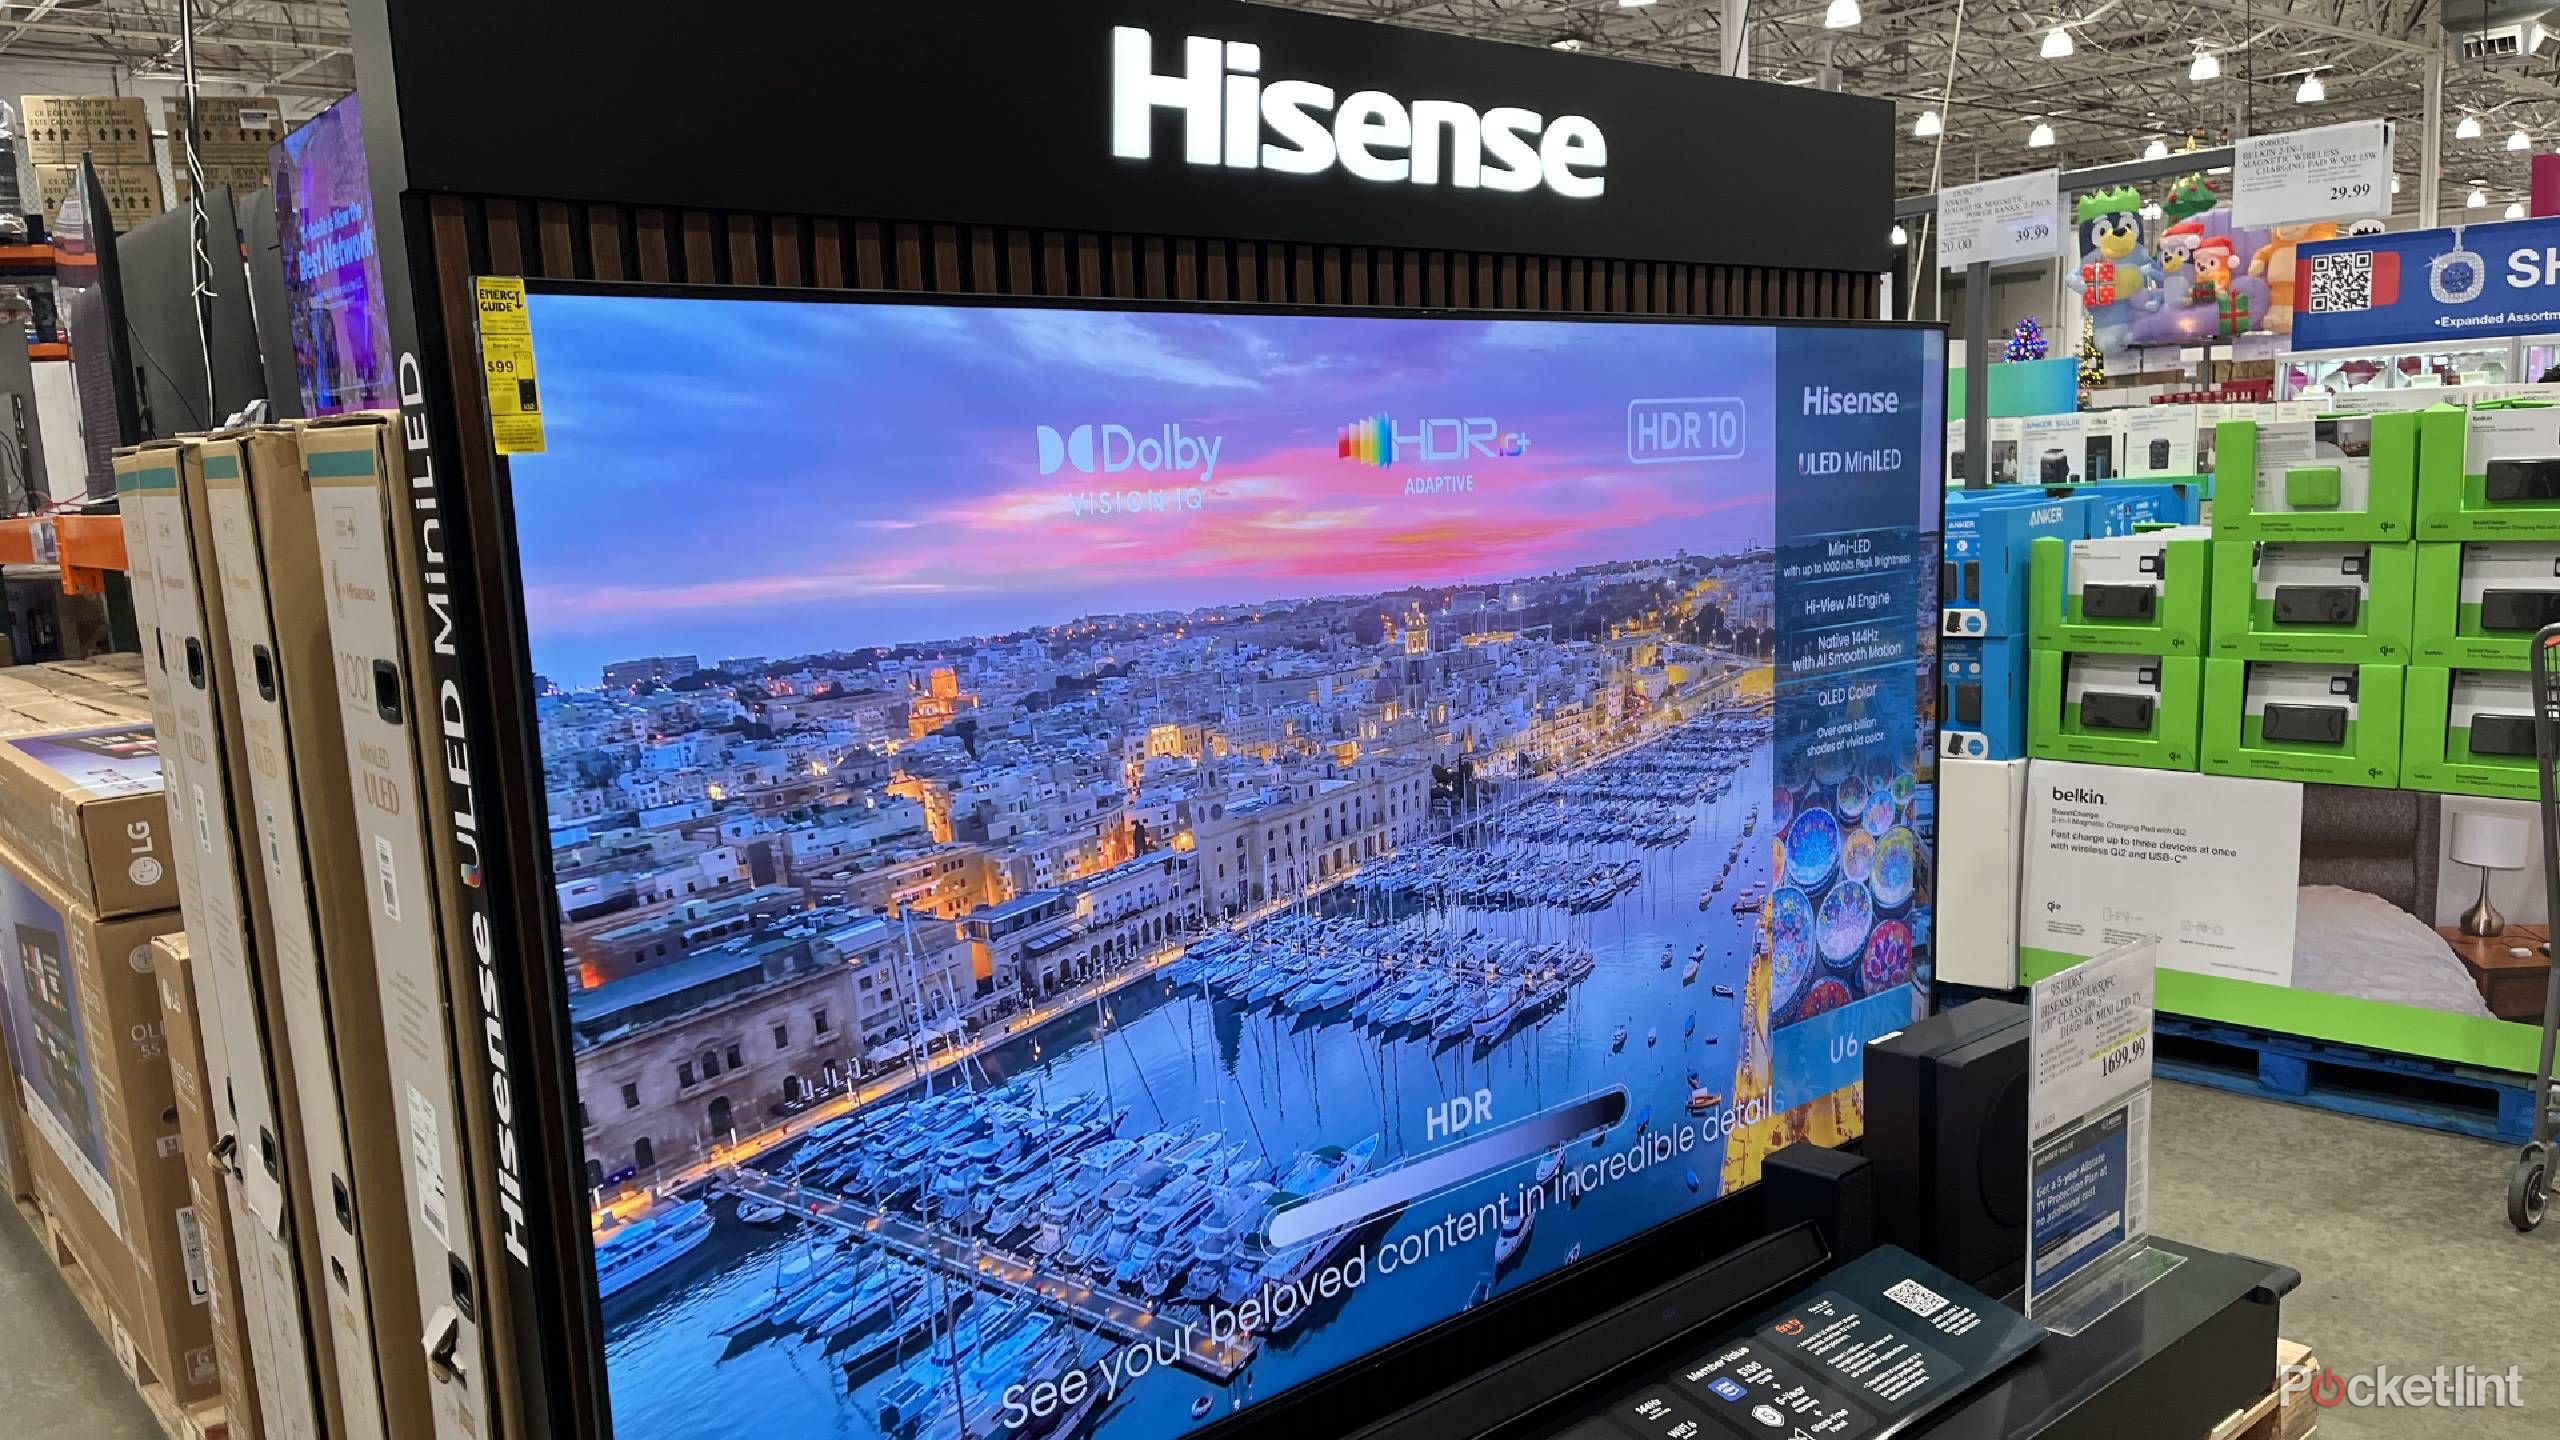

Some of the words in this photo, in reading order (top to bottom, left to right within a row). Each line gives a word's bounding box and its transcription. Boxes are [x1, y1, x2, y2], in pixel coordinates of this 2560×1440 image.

[1113, 26, 1607, 198] Hisense
[2294, 148, 2340, 161] WIRELESS
[2255, 162, 2305, 176] CHARGING
[2330, 183, 2371, 200] 29.99
[2015, 227, 2049, 243] 39.99
[298, 243, 324, 282] Best
[323, 221, 374, 273] Network
[480, 289, 521, 305] ENERGY
[480, 301, 513, 313] GUIDE
[487, 360, 513, 373] $99
[1803, 386, 1899, 416] Hisense
[1638, 412, 1701, 451] HDR
[1708, 410, 1738, 449] 10
[1101, 423, 1222, 482] Dolby
[1798, 452, 1842, 476] ULED
[1845, 449, 1902, 473] MiniLED
[1404, 474, 1474, 496] ADAPTIVE
[399, 352, 457, 657] MiniLED
[1069, 488, 1165, 517] VISION
[1176, 487, 1203, 513] IQ
[1948, 521, 1976, 529] ANKER
[2028, 507, 2064, 527] ANKER
[1828, 539, 1872, 557] Mini-LED
[1784, 564, 1801, 577] with
[1802, 564, 1813, 577] up
[1814, 562, 1822, 574] to
[1823, 560, 1840, 573] 1000
[1855, 556, 1874, 570] Peak
[1805, 597, 1845, 616] Hi-View
[1846, 594, 1856, 610] AI
[1858, 591, 1890, 610] Engine
[1818, 633, 1850, 651] Native
[1851, 628, 1880, 645] 144Hz
[1792, 655, 1816, 672] with
[1816, 654, 1826, 668] AI
[1828, 646, 1868, 666] Smooth
[1868, 642, 1902, 660] Motion
[1818, 688, 1846, 706] QLED
[1847, 682, 1878, 701] Color
[1816, 727, 1836, 738] Over
[1807, 741, 1836, 757] shades
[362, 768, 400, 816] ULED
[441, 679, 482, 889] ULED
[127, 821, 154, 854] LG
[2051, 829, 2071, 839] Fast
[2072, 832, 2105, 845] charge
[2106, 836, 2119, 846] up
[2120, 836, 2130, 846] to
[2132, 838, 2157, 849] three
[2159, 841, 2198, 854] devices
[2199, 844, 2210, 854] at
[2211, 847, 2237, 857] once
[2050, 841, 2069, 851] with
[2071, 843, 2109, 857] wireless
[2128, 849, 2146, 860] and
[2040, 994, 2073, 1019] HISENSE
[2057, 1007, 2084, 1026] CLASS
[2096, 1007, 2114, 1022] MINI
[1830, 1032, 1858, 1064] U6
[2102, 1036, 2146, 1078] 1699.99
[472, 911, 528, 1268] Hisense
[1426, 1088, 1493, 1141] HDR
[2036, 1199, 2046, 1213] TV
[2047, 1180, 2084, 1208] Protection
[2084, 1171, 2100, 1186] Plan
[1002, 1369, 1088, 1429] See
[1099, 1318, 1198, 1401] your
[1209, 1245, 1367, 1345] beloved
[1378, 1190, 1510, 1275] content
[1518, 1182, 1545, 1219] in
[1554, 1123, 1695, 1205] incredible
